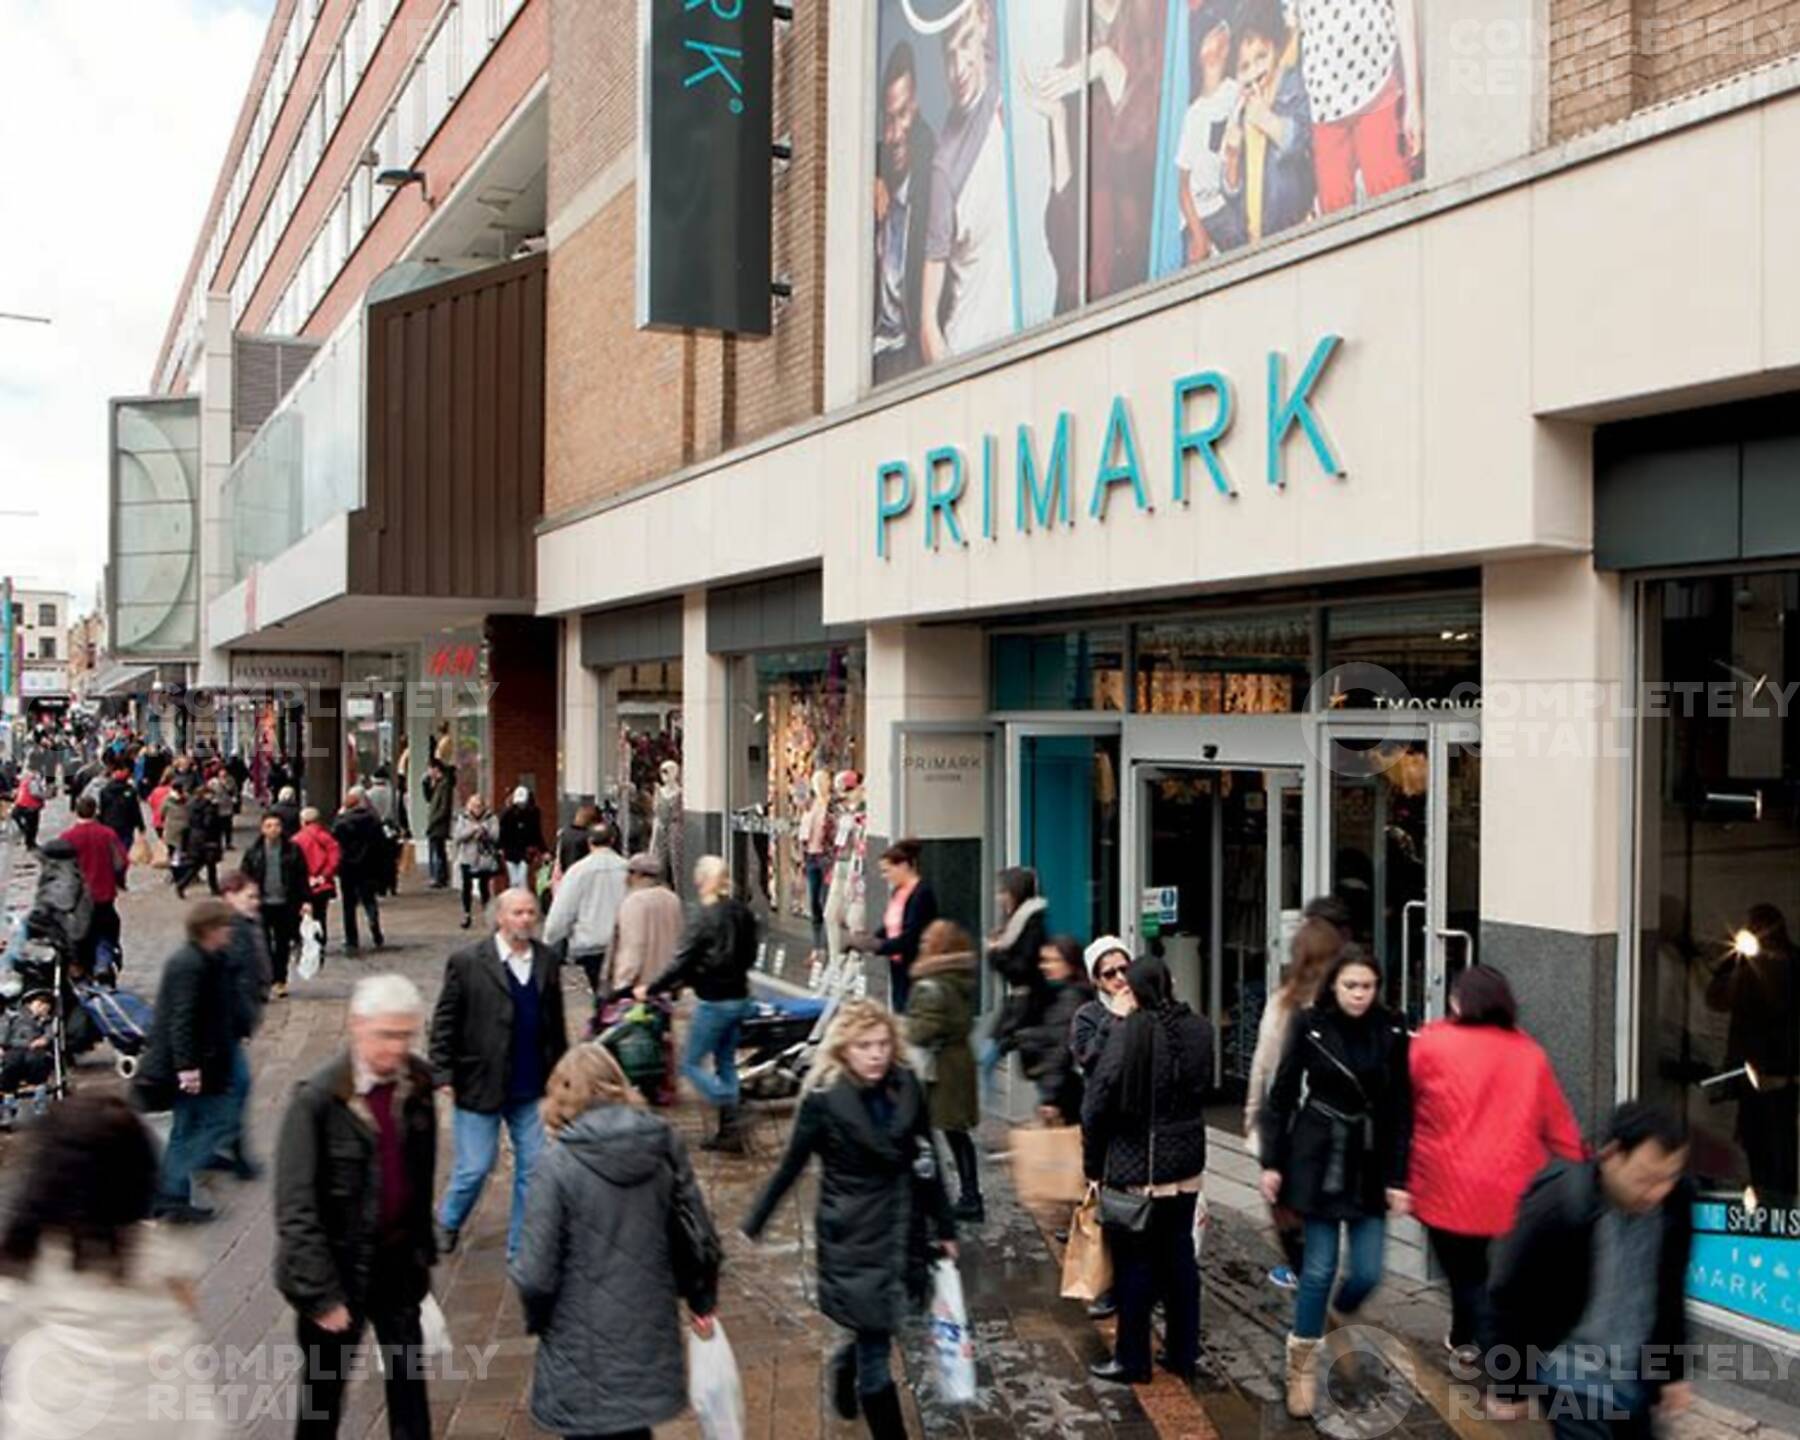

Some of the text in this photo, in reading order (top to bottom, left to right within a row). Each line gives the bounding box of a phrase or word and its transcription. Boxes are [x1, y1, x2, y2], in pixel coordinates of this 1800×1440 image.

[876, 334, 1345, 560] PRIMARK
[904, 755, 981, 769] PRIMARK
[1728, 1205, 1768, 1232] SHOP
